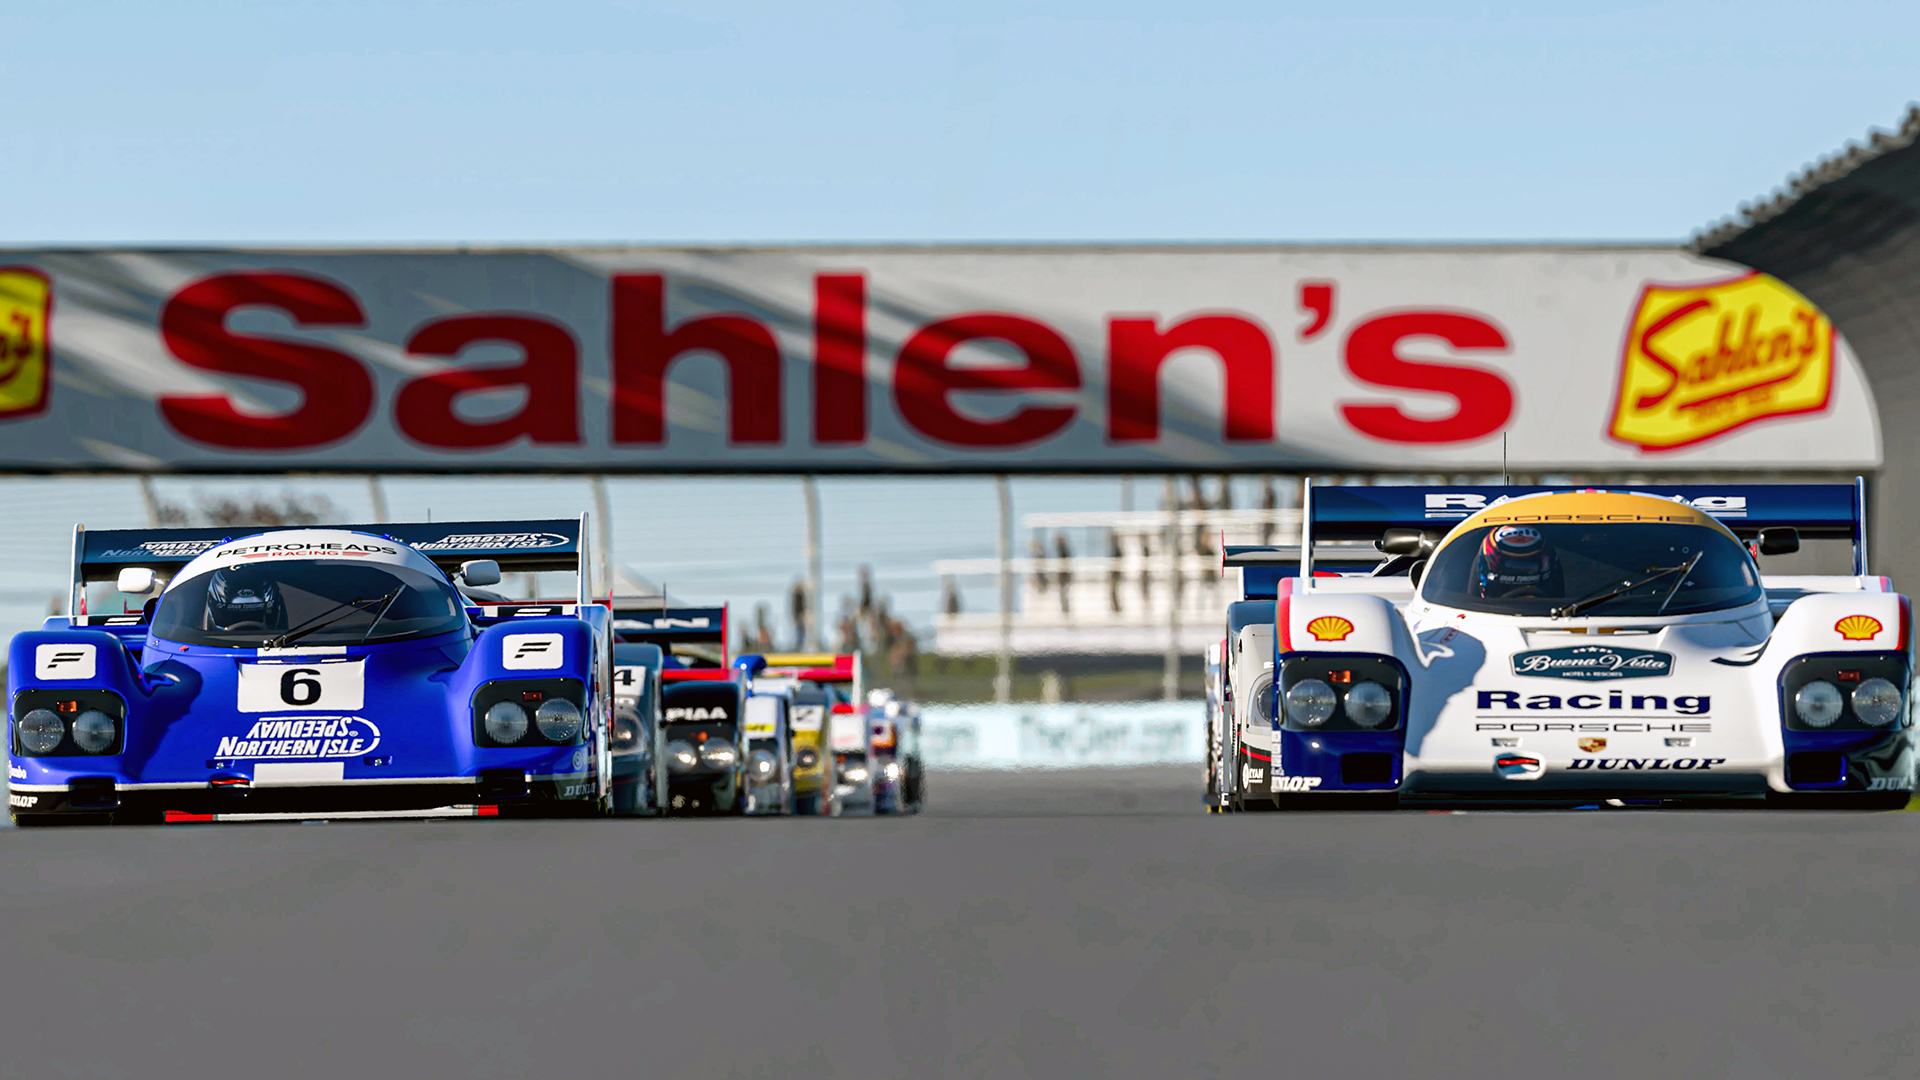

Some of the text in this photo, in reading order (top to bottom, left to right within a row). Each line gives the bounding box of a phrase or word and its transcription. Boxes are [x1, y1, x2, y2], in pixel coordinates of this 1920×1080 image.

[156, 270, 1517, 451] Sahlen's
[1483, 513, 1695, 524] PORSCHE
[216, 543, 398, 558] PETROHEADS
[1516, 654, 1667, 672] Buena Vista
[279, 668, 323, 707] 6
[1476, 690, 1711, 715] Racing
[665, 706, 729, 721] PIAA
[246, 716, 353, 739] SPEEDWAY
[1476, 723, 1712, 733] PORSCHE
[216, 736, 365, 758] NORTHERN ISLE
[1565, 758, 1727, 770] DUNLOP
